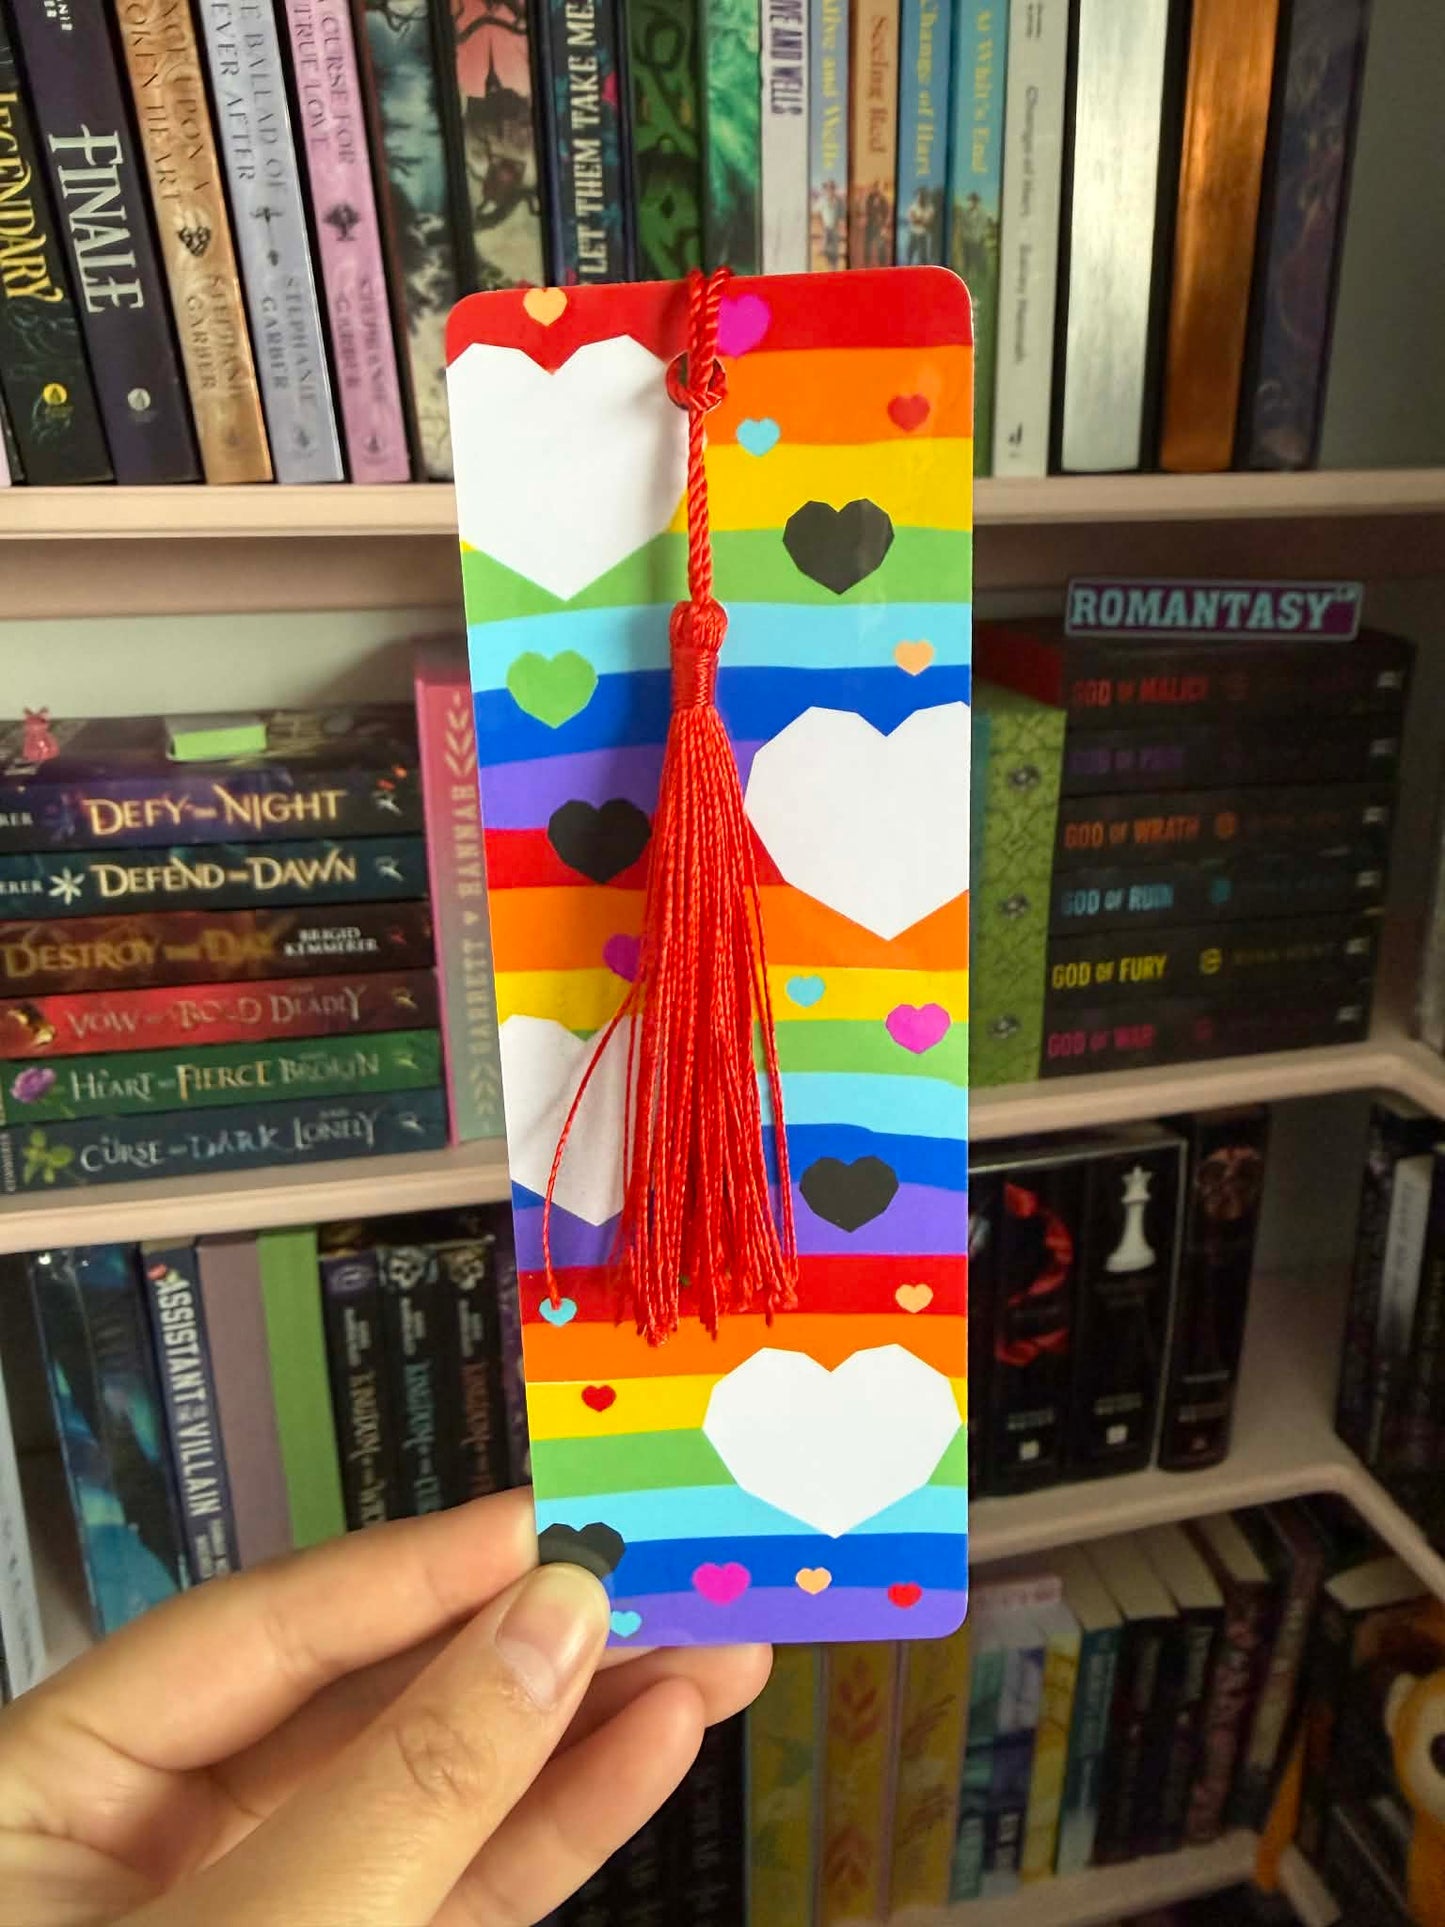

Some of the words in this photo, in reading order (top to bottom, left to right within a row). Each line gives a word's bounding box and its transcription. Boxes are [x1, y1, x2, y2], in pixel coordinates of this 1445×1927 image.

[321, 15, 349, 105] CURSE
[770, 28, 803, 60] AND
[242, 33, 278, 144] BALLAD
[566, 55, 600, 128] TAKE
[769, 66, 803, 115] WELLS
[821, 57, 839, 98] and
[303, 83, 331, 152] LOVE
[917, 90, 935, 118] of
[146, 105, 181, 200] HEART
[226, 89, 256, 181] AFTER
[332, 115, 356, 165] FOR
[867, 107, 888, 153] Red
[915, 122, 935, 176] Hart
[970, 127, 990, 174] End
[0, 92, 64, 304] ENDARY
[573, 139, 605, 219] THEM
[48, 124, 145, 313] FINALE
[577, 229, 608, 274] LET
[187, 295, 216, 389] GARBER
[263, 296, 289, 389] GARBER
[1067, 588, 1333, 632] ROMANTASY
[82, 794, 190, 837] DEFY
[212, 784, 348, 831] NIGHT
[89, 855, 225, 898] DEFEND
[246, 847, 358, 891] DAWN
[3, 939, 159, 978] DESTROY
[206, 928, 278, 962] DAY
[1052, 962, 1091, 989] GOD
[1119, 954, 1168, 982] FURY
[67, 1006, 136, 1039] VOW
[1047, 1031, 1085, 1057] GOD
[69, 1068, 154, 1103] HEART
[80, 1135, 167, 1173] CURSE
[155, 1281, 207, 1402] ASSISTANT
[177, 1421, 221, 1517] VILLAIN
